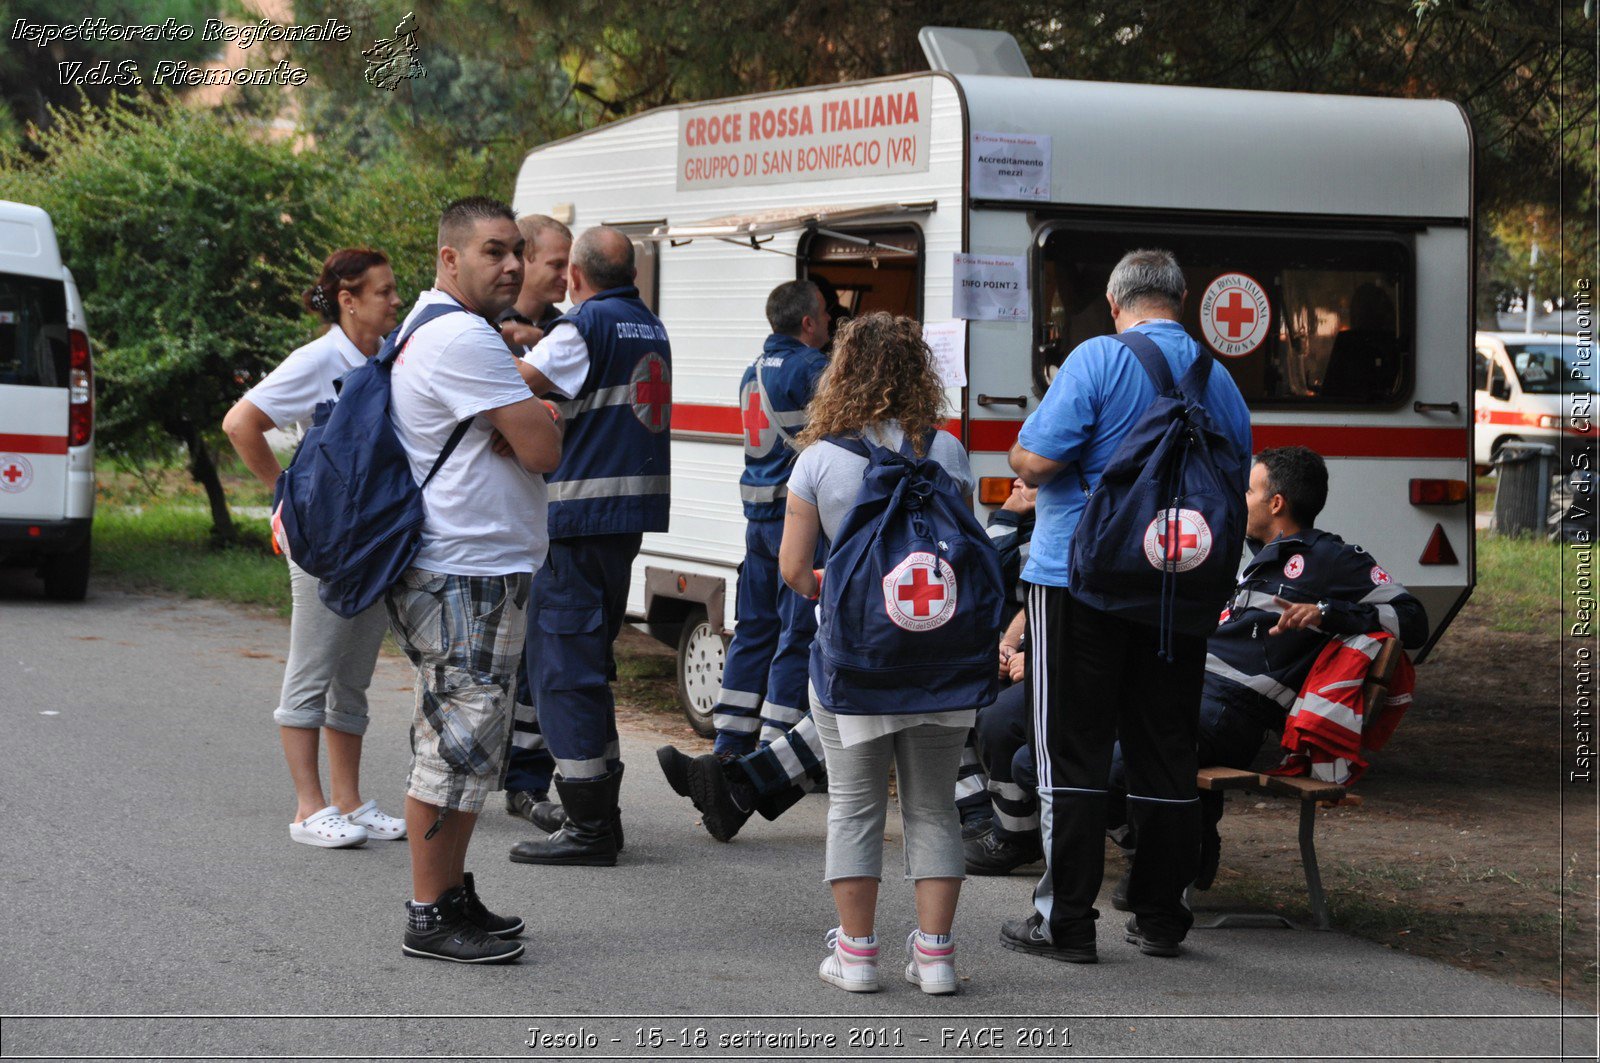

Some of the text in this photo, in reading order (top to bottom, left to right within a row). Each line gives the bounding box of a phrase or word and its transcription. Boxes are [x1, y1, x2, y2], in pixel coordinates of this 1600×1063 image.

[685, 91, 919, 147] CROCE ROSSA ITALIANA
[685, 135, 917, 181] GRUPPO DI SAN BONIFACIO (VR)
[978, 156, 1044, 167] Accreditamento
[998, 169, 1023, 177] mezzi
[962, 279, 981, 288] INFO
[983, 281, 1010, 289] POINT
[1203, 276, 1268, 318] CROCE ROSSA ITALIANA
[616, 322, 639, 339] CROCE
[637, 323, 656, 340] ROSSA
[1212, 335, 1256, 353] VERONA
[925, 599, 956, 629] SOCCORSO
